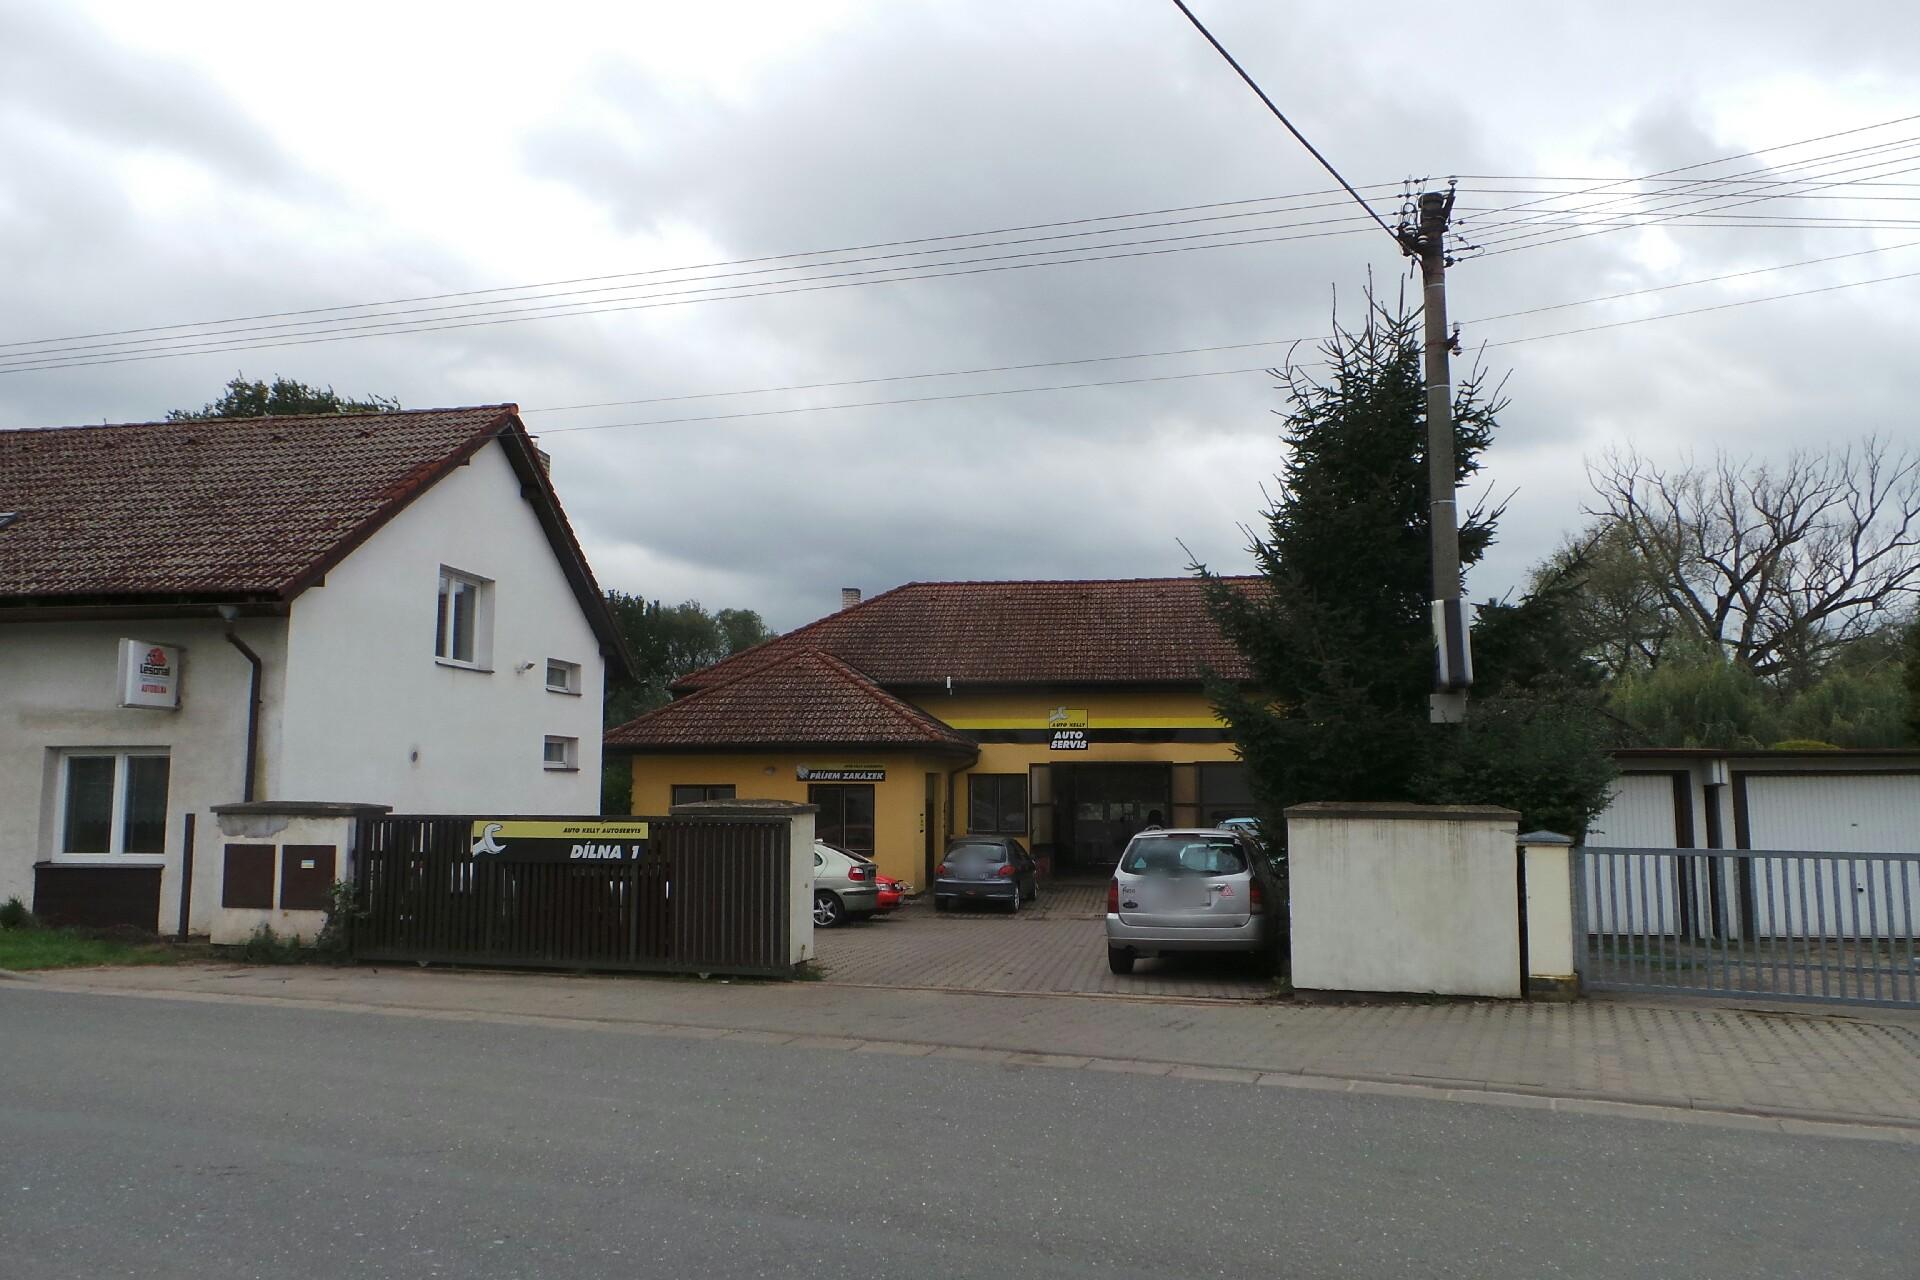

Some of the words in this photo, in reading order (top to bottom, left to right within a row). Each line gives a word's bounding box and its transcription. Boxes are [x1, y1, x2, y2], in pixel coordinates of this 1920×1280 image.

[1054, 731, 1084, 739] AUTO
[1051, 740, 1087, 749] SERVIS
[809, 770, 840, 780] PŘÍJEM
[842, 770, 884, 780] ZAKÁZEK
[570, 841, 622, 859] DÍLNA
[631, 845, 640, 860] 1
